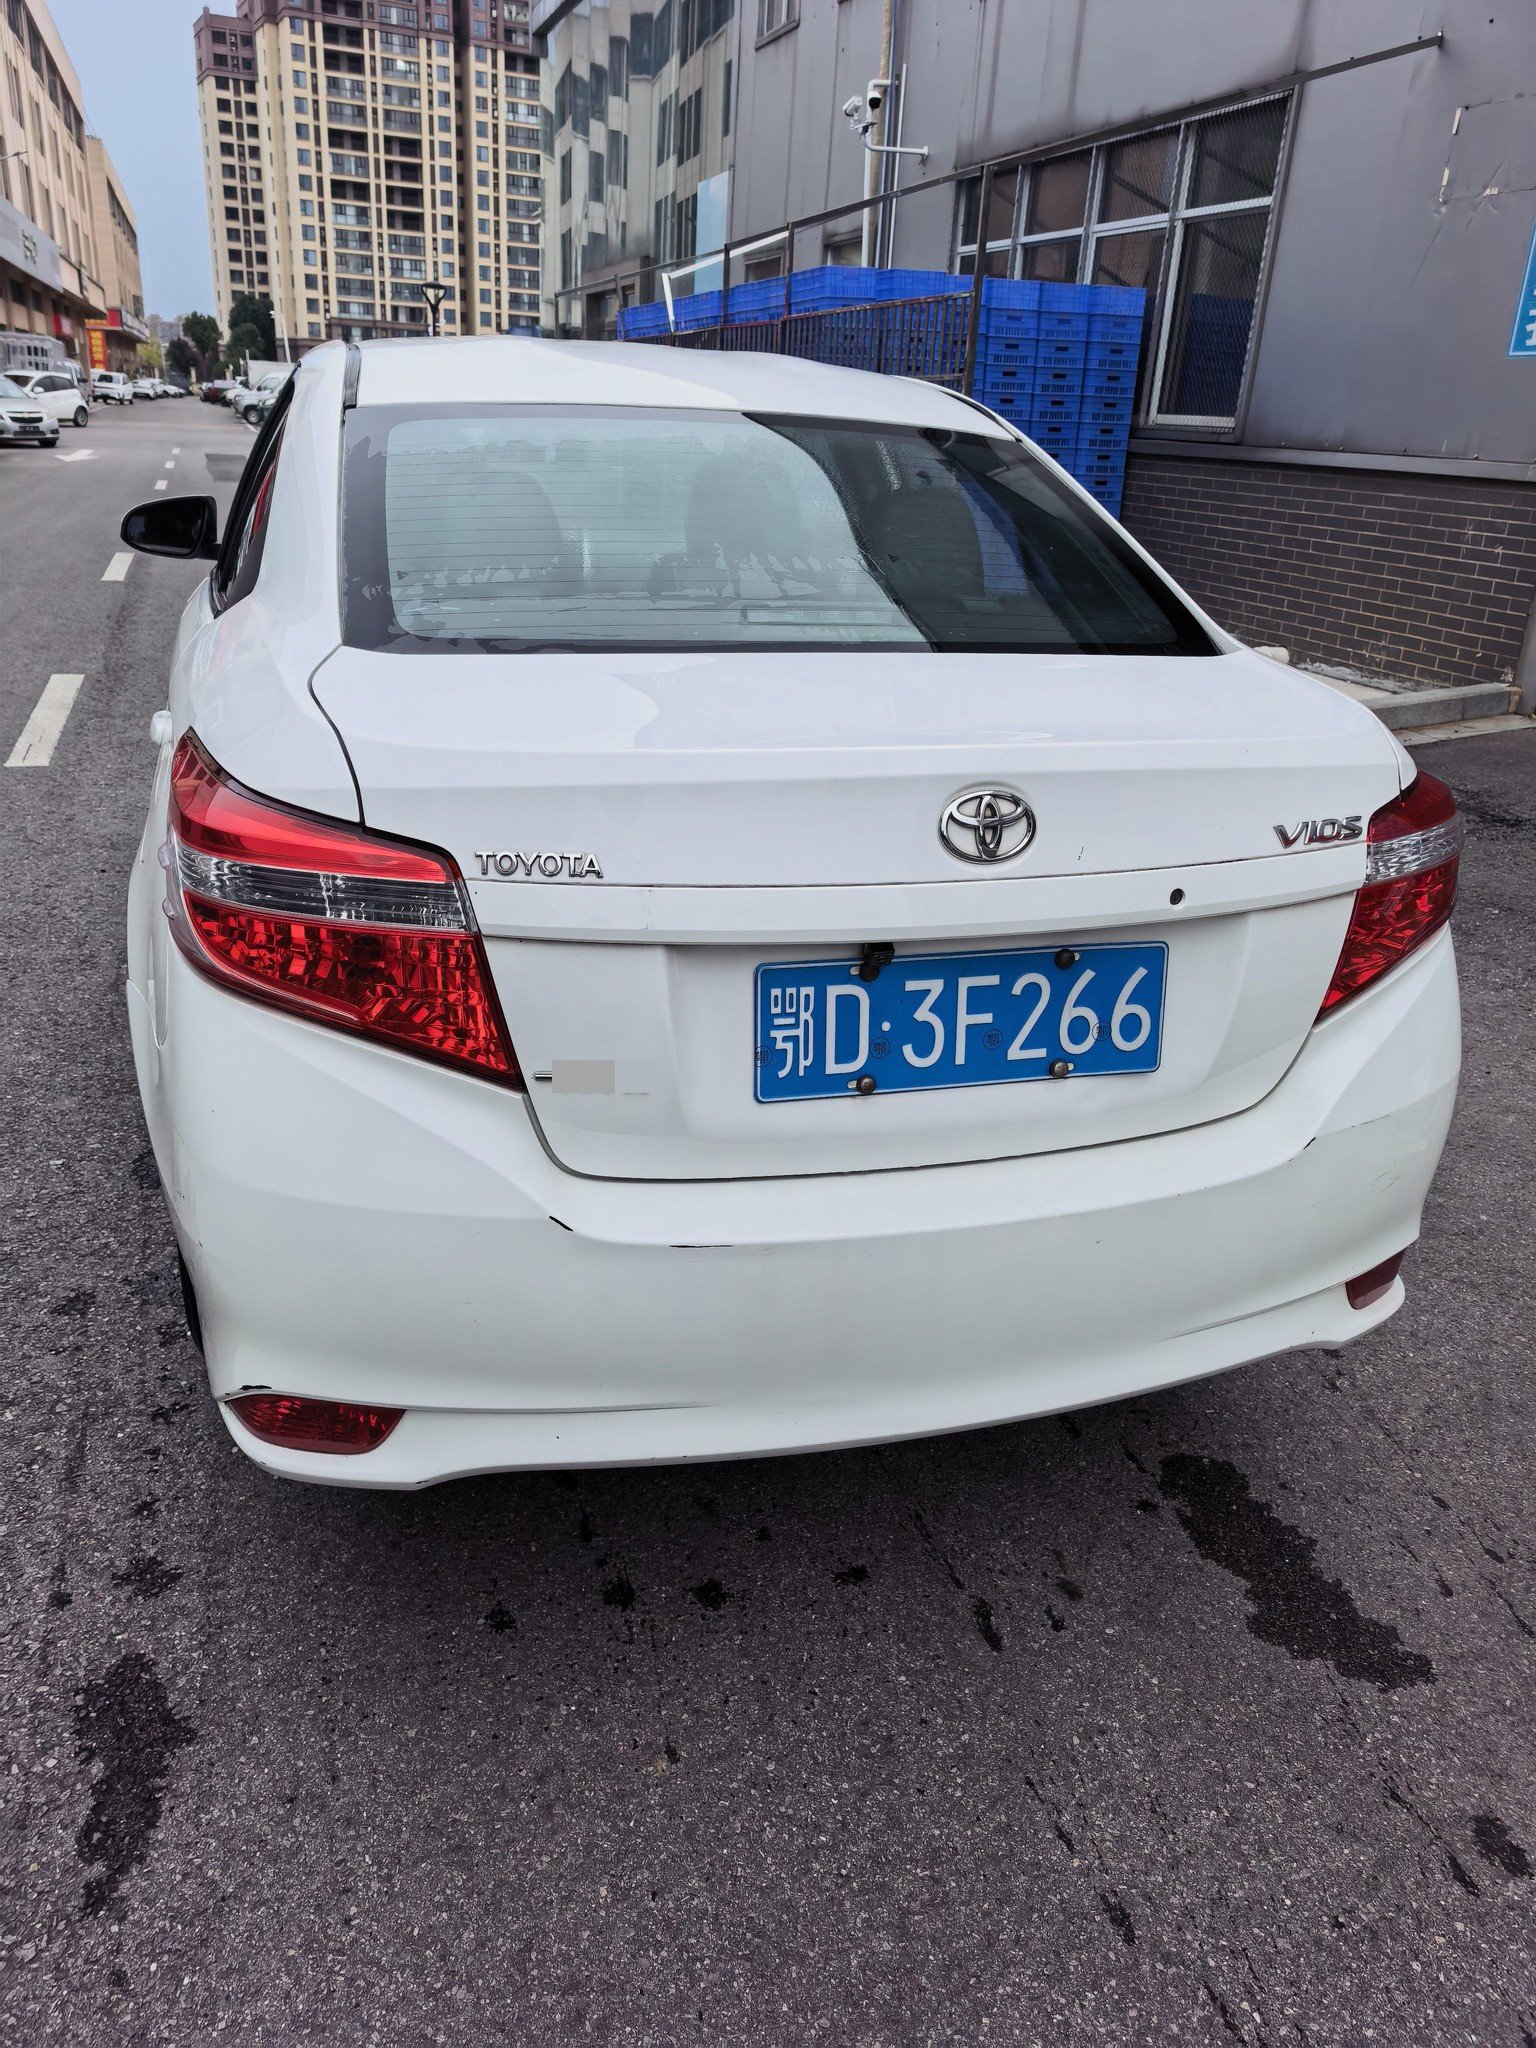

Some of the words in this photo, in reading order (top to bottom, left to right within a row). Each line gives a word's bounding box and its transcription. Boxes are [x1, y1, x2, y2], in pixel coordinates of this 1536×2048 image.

[1273, 815, 1363, 849] VIOS
[475, 851, 603, 878] TOYOTA
[769, 966, 1152, 1079] 鄂D·3F266
